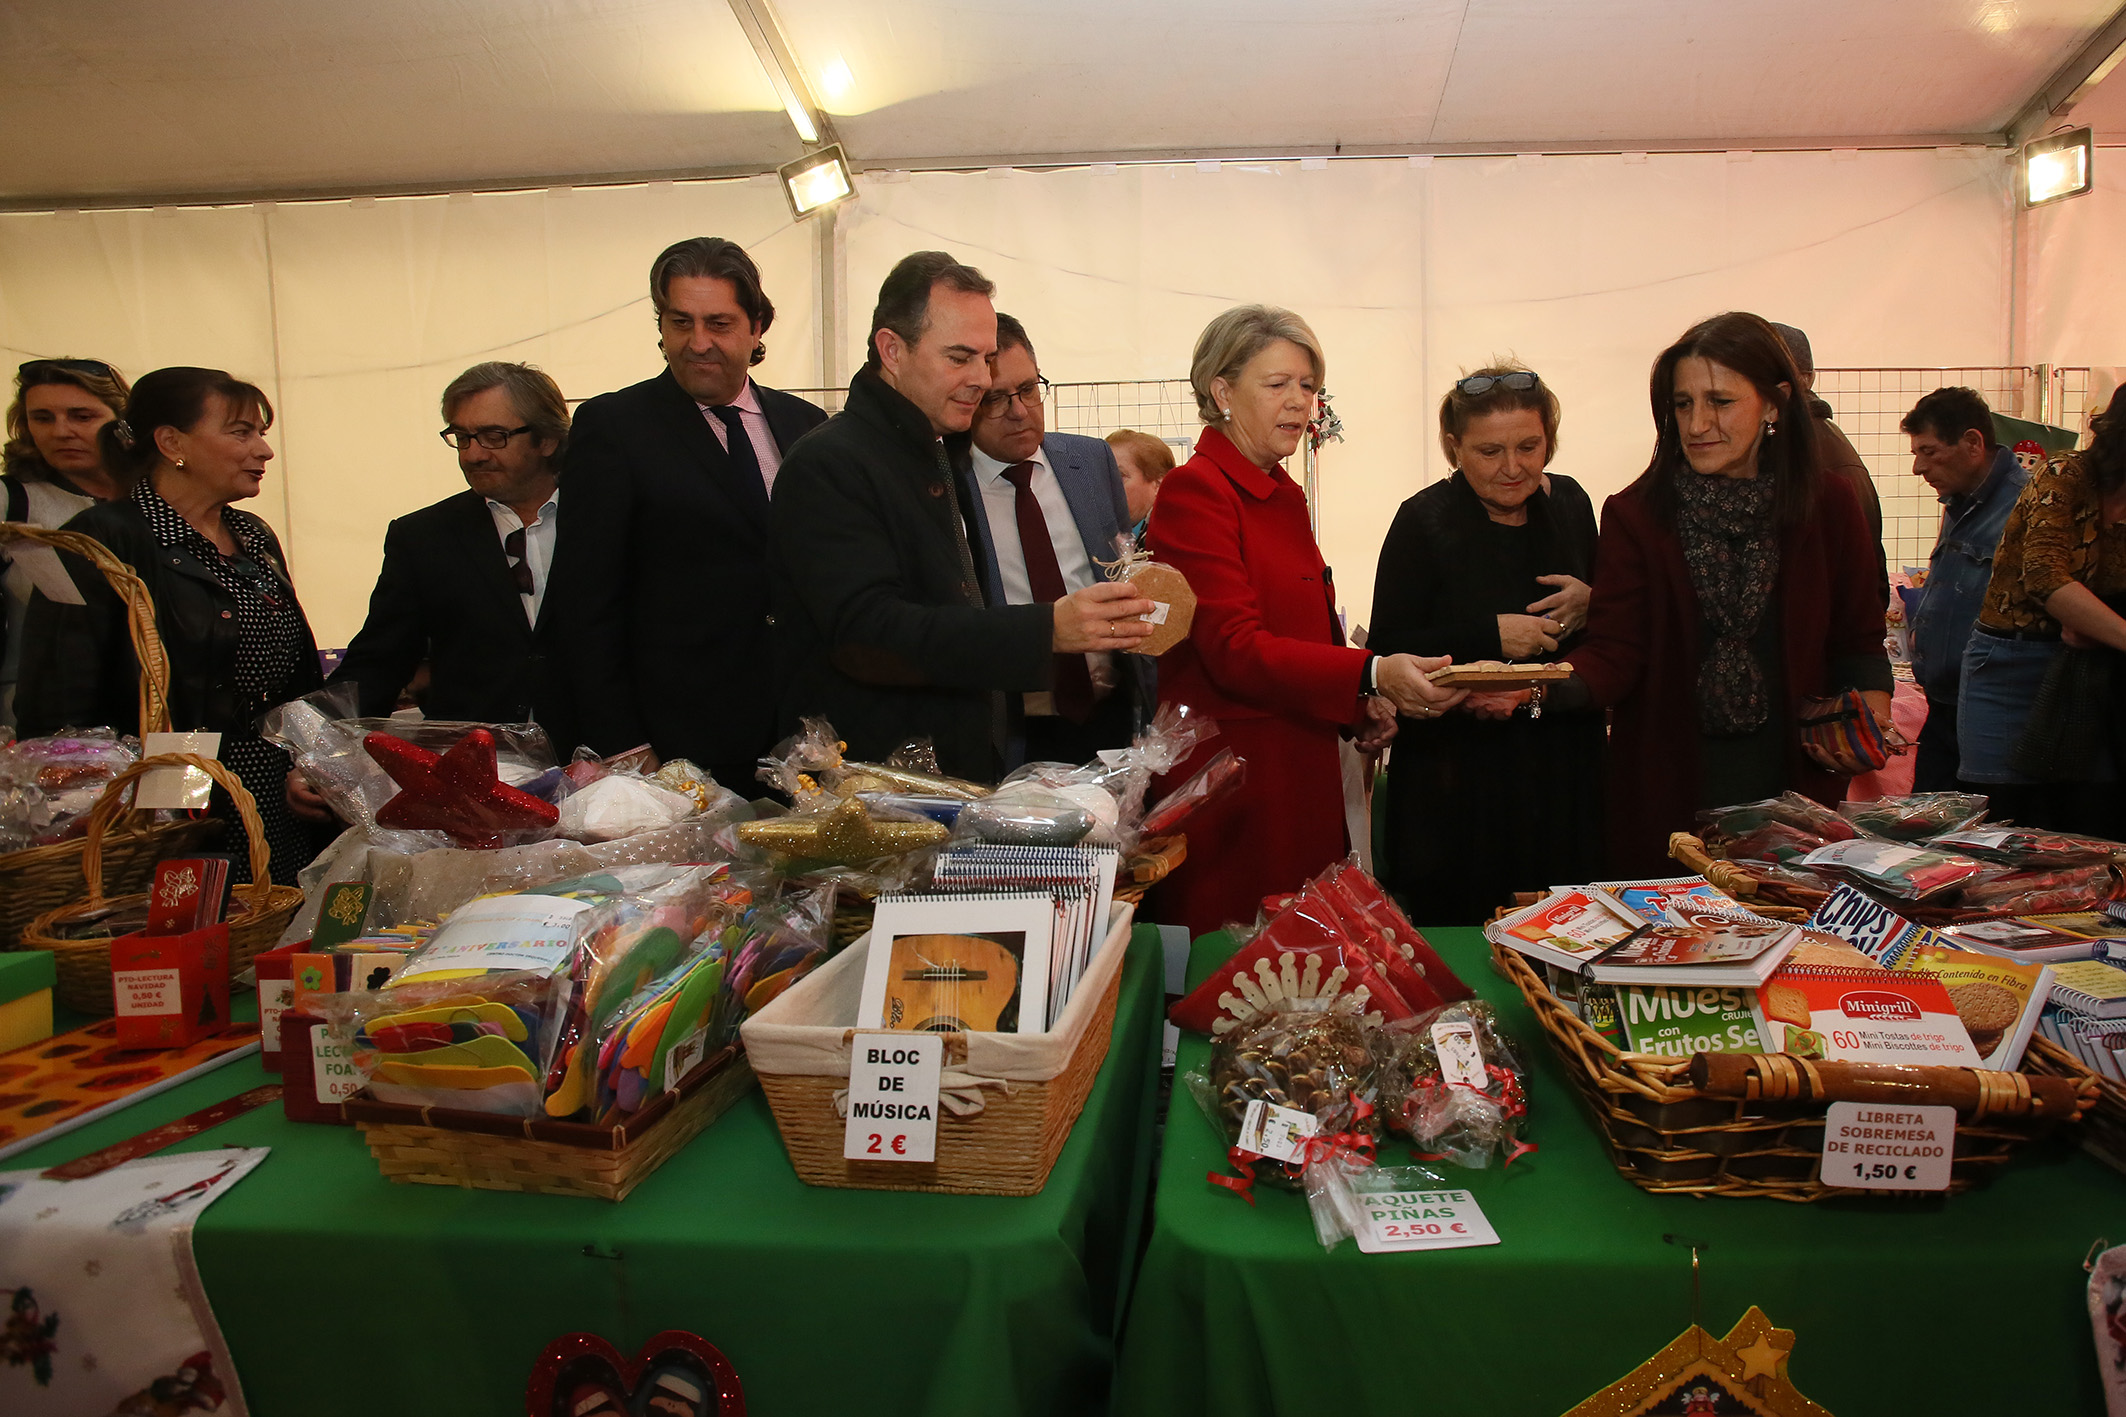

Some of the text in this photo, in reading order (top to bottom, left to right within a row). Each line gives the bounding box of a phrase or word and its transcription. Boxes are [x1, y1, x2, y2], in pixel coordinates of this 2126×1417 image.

[1815, 886, 1894, 935] Chips
[118, 974, 174, 983] PTO-LECTURA
[127, 982, 166, 990] NAVIDAD
[1938, 968, 1986, 980] Contenido
[1987, 974, 2000, 982] en
[2000, 974, 2028, 991] Fibra
[132, 991, 162, 1000] 0,50 €
[131, 1001, 165, 1009] UNIDAD
[1629, 986, 1751, 1025] Mues
[1846, 1000, 1913, 1015] Minigrill
[1658, 1026, 1680, 1037] con
[1639, 1025, 1760, 1057] Frutos Se
[1832, 1030, 1946, 1050] 60 Mini Tostas de trigo
[1863, 1041, 1965, 1053] Mini Biscottes de trigo
[867, 1049, 920, 1065] BLOC
[326, 1063, 356, 1075] FOA
[329, 1083, 358, 1097] 0,50
[878, 1076, 904, 1092] DE
[853, 1100, 931, 1121] MÚSICA
[1857, 1111, 1924, 1125] LIBRETA
[1840, 1126, 1936, 1141] SOBREMESA
[866, 1133, 907, 1155] 2 €
[1827, 1141, 1944, 1158] DE RECICLADO
[1853, 1163, 1917, 1180] 1,50 €
[1364, 1192, 1466, 1207] AQUETE
[1371, 1206, 1456, 1221] PIÑAS
[1384, 1222, 1467, 1238] 2,50 €
